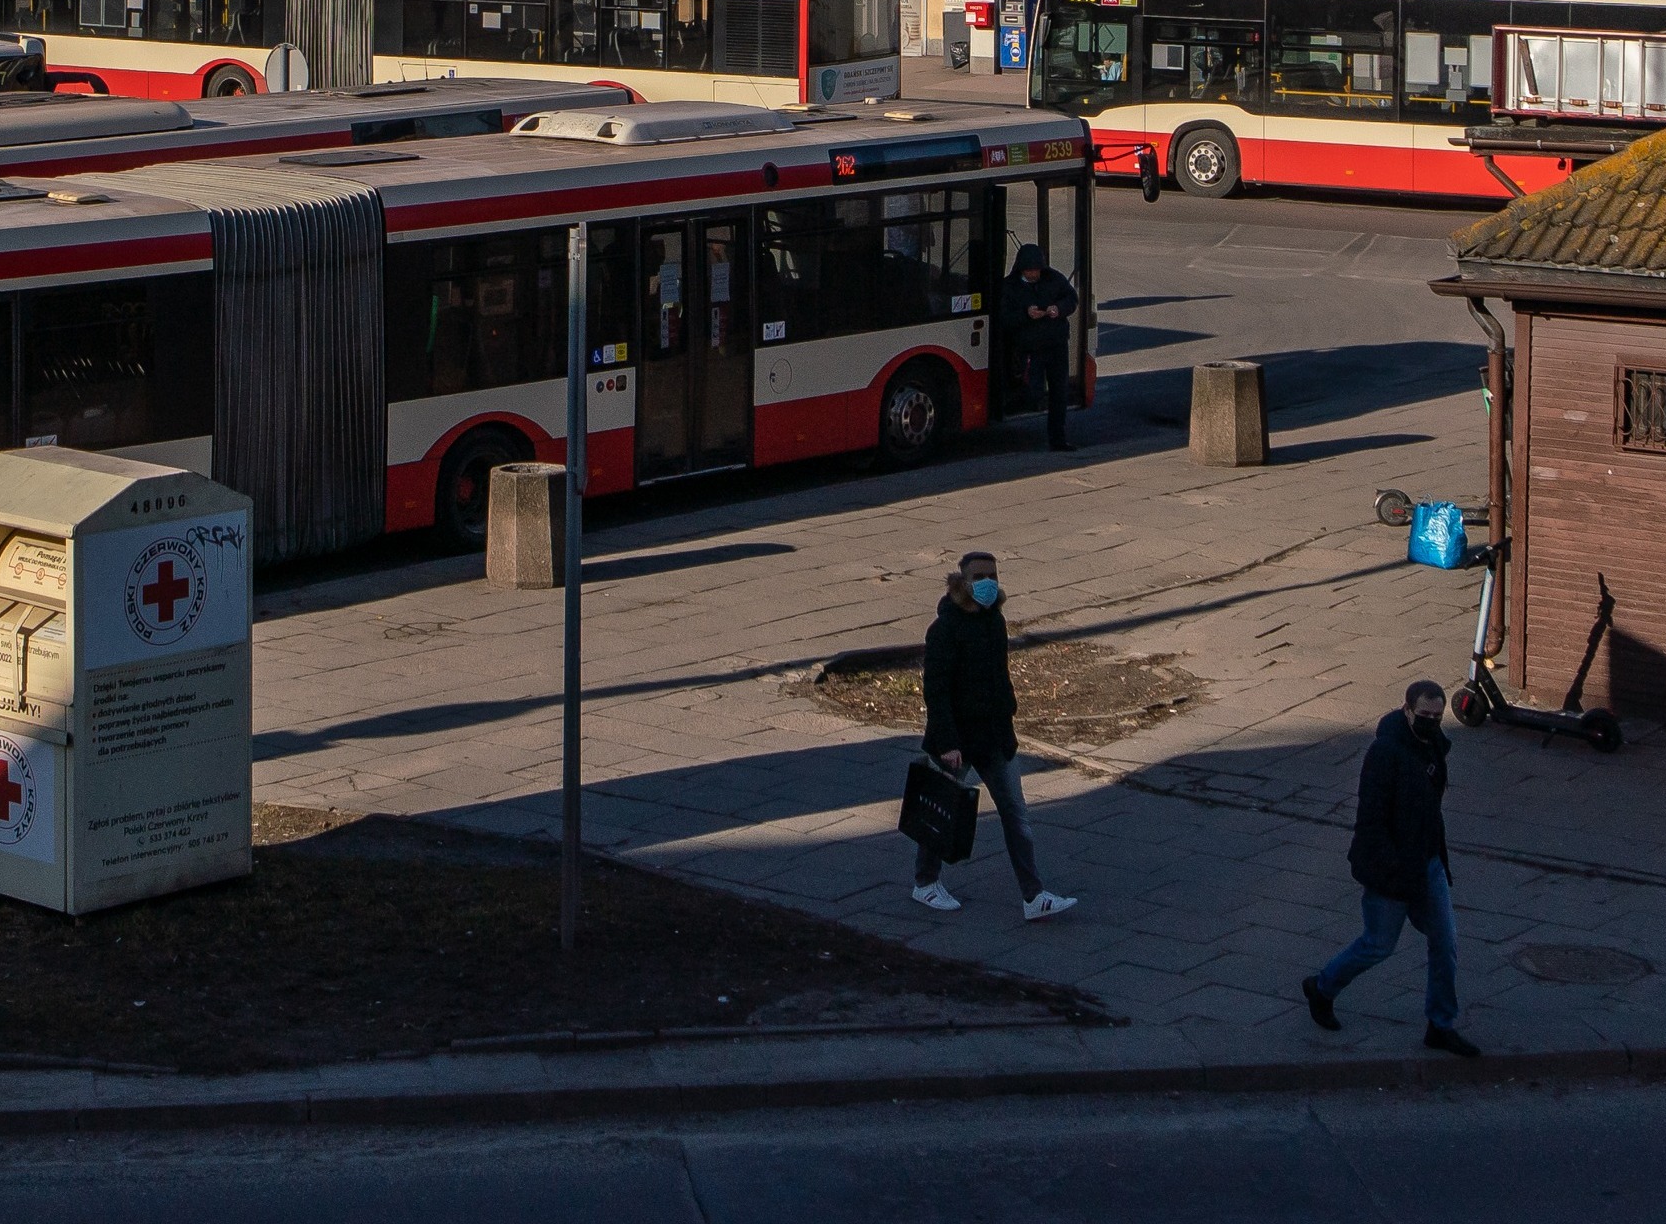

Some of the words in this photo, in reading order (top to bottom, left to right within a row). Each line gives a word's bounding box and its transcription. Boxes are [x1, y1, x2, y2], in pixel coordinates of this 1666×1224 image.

[1044, 140, 1073, 160] 2539
[835, 154, 855, 177] 262
[129, 494, 187, 515] 48096
[36, 550, 63, 564] Pomagaj
[133, 540, 202, 575] CZERWONY
[126, 585, 153, 640] POLSKI
[179, 577, 205, 633] KRZYŻ
[93, 680, 117, 694] Dzięki
[118, 677, 152, 691] Twojemu
[152, 670, 185, 684] wsparciu
[185, 662, 227, 680] pozyskamy
[93, 693, 117, 708] środki
[97, 704, 140, 719] dożywianie
[140, 697, 175, 713] głodnych
[175, 691, 197, 704] dzieci
[97, 718, 132, 734] poprawę
[131, 714, 151, 726] życia
[151, 704, 211, 722] najbiedniejszych
[211, 697, 235, 709] rodzin
[97, 730, 136, 744] tworzenie
[136, 725, 160, 738] miejsc
[160, 719, 190, 734] pomocy
[97, 745, 110, 757] dla
[110, 735, 167, 755] potrzebujących
[14, 788, 35, 839] KRZYŻ
[123, 823, 147, 838] Polski
[147, 817, 186, 833] Czerwony
[186, 810, 209, 825] Krzyż
[101, 854, 129, 868] Telefon
